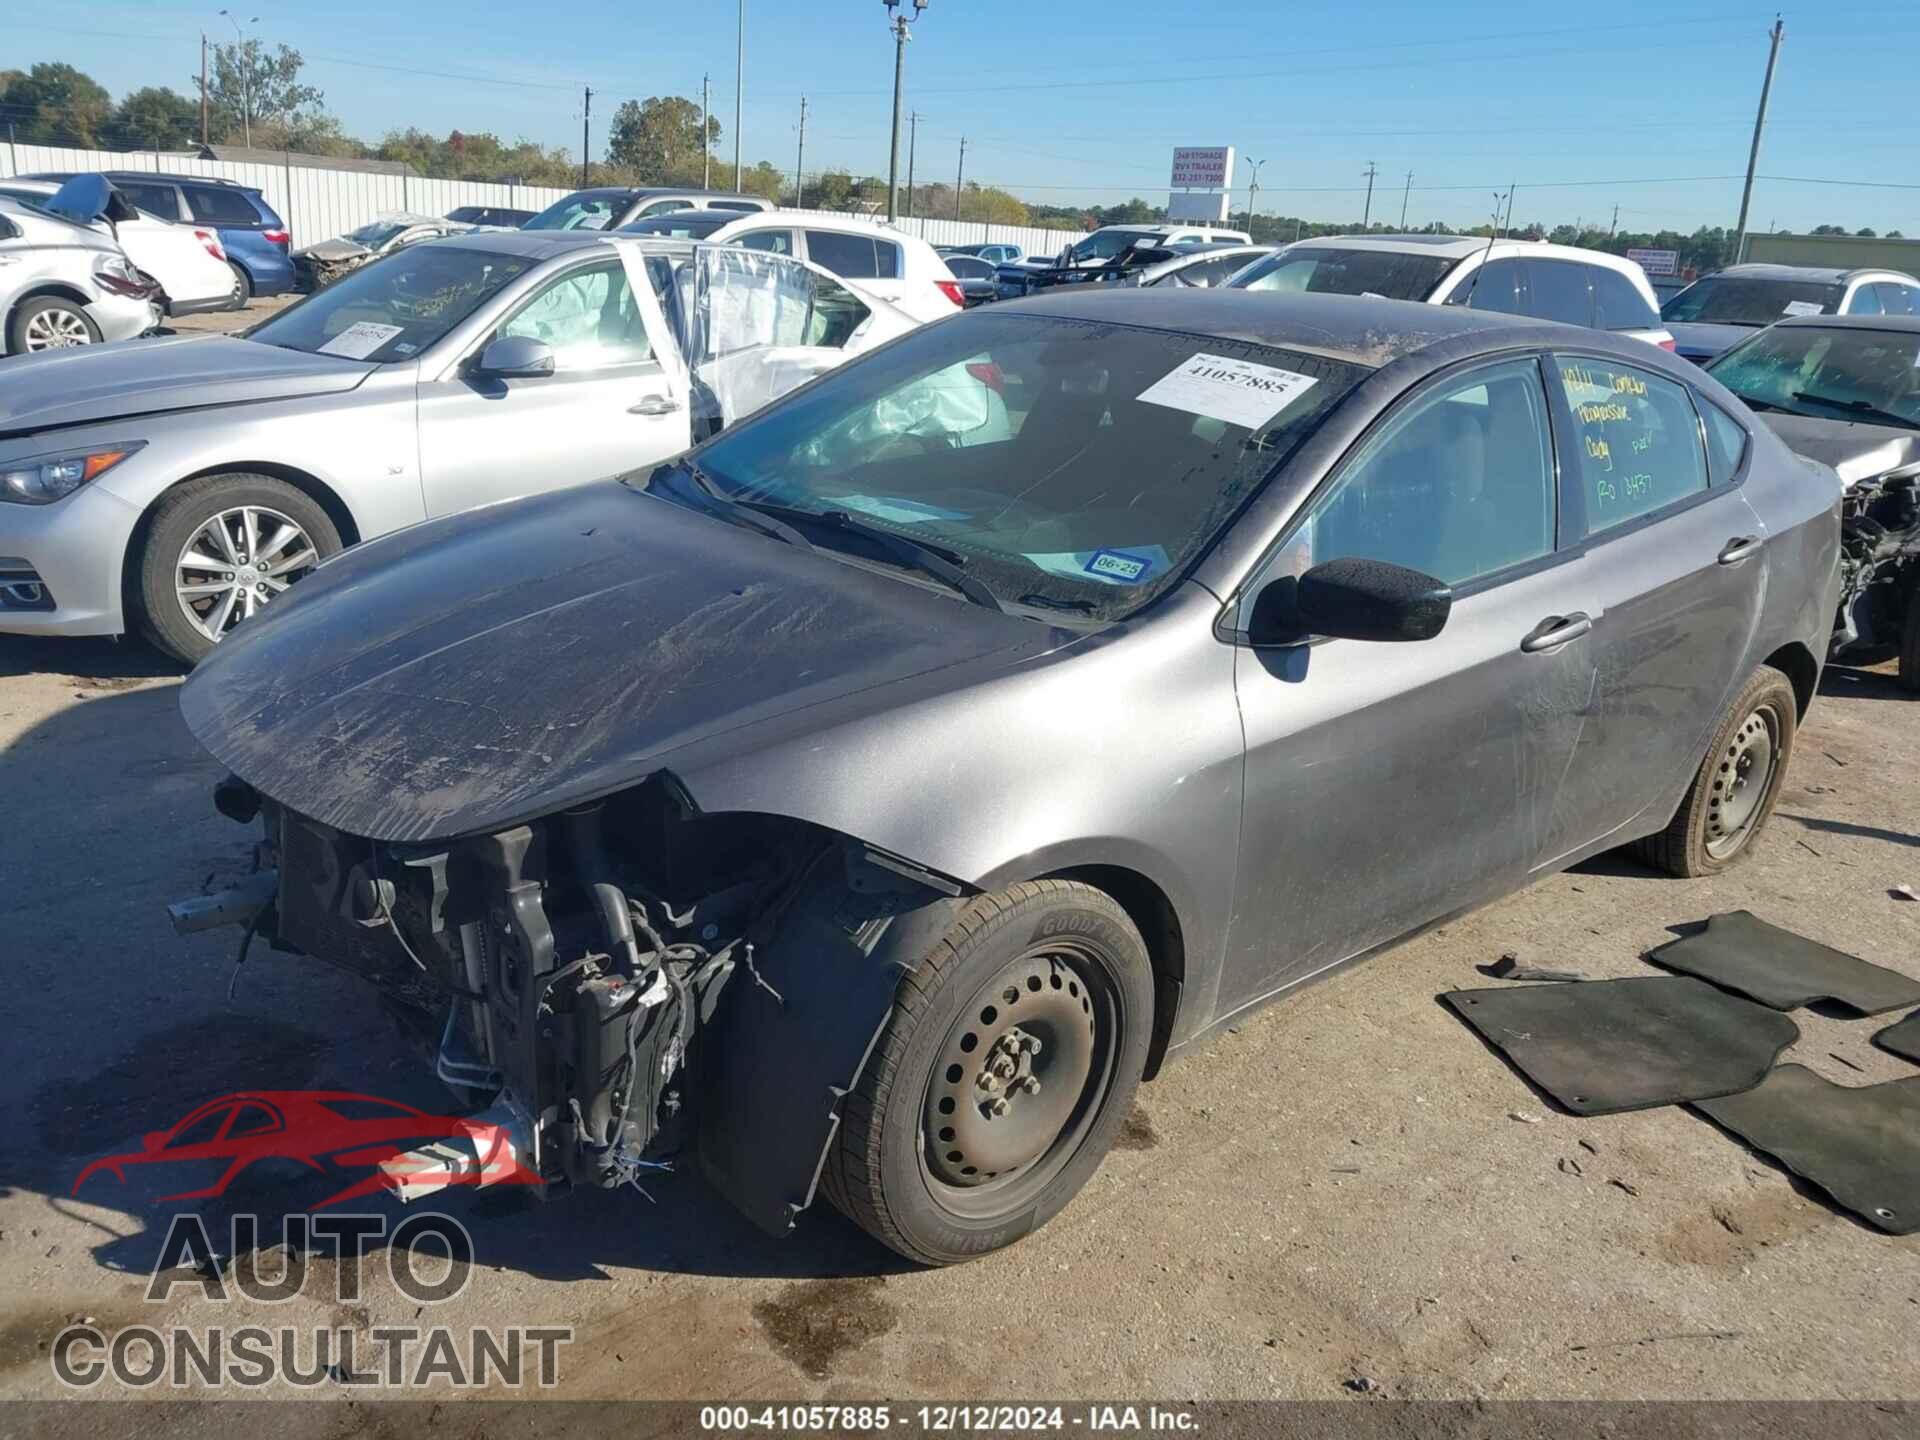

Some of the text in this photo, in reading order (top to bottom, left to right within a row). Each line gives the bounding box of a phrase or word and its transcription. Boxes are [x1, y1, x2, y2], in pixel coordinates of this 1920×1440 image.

[1192, 162, 1223, 170] TRAILER
[1188, 365, 1289, 394] 41057885
[1097, 557, 1141, 574] 06-25
